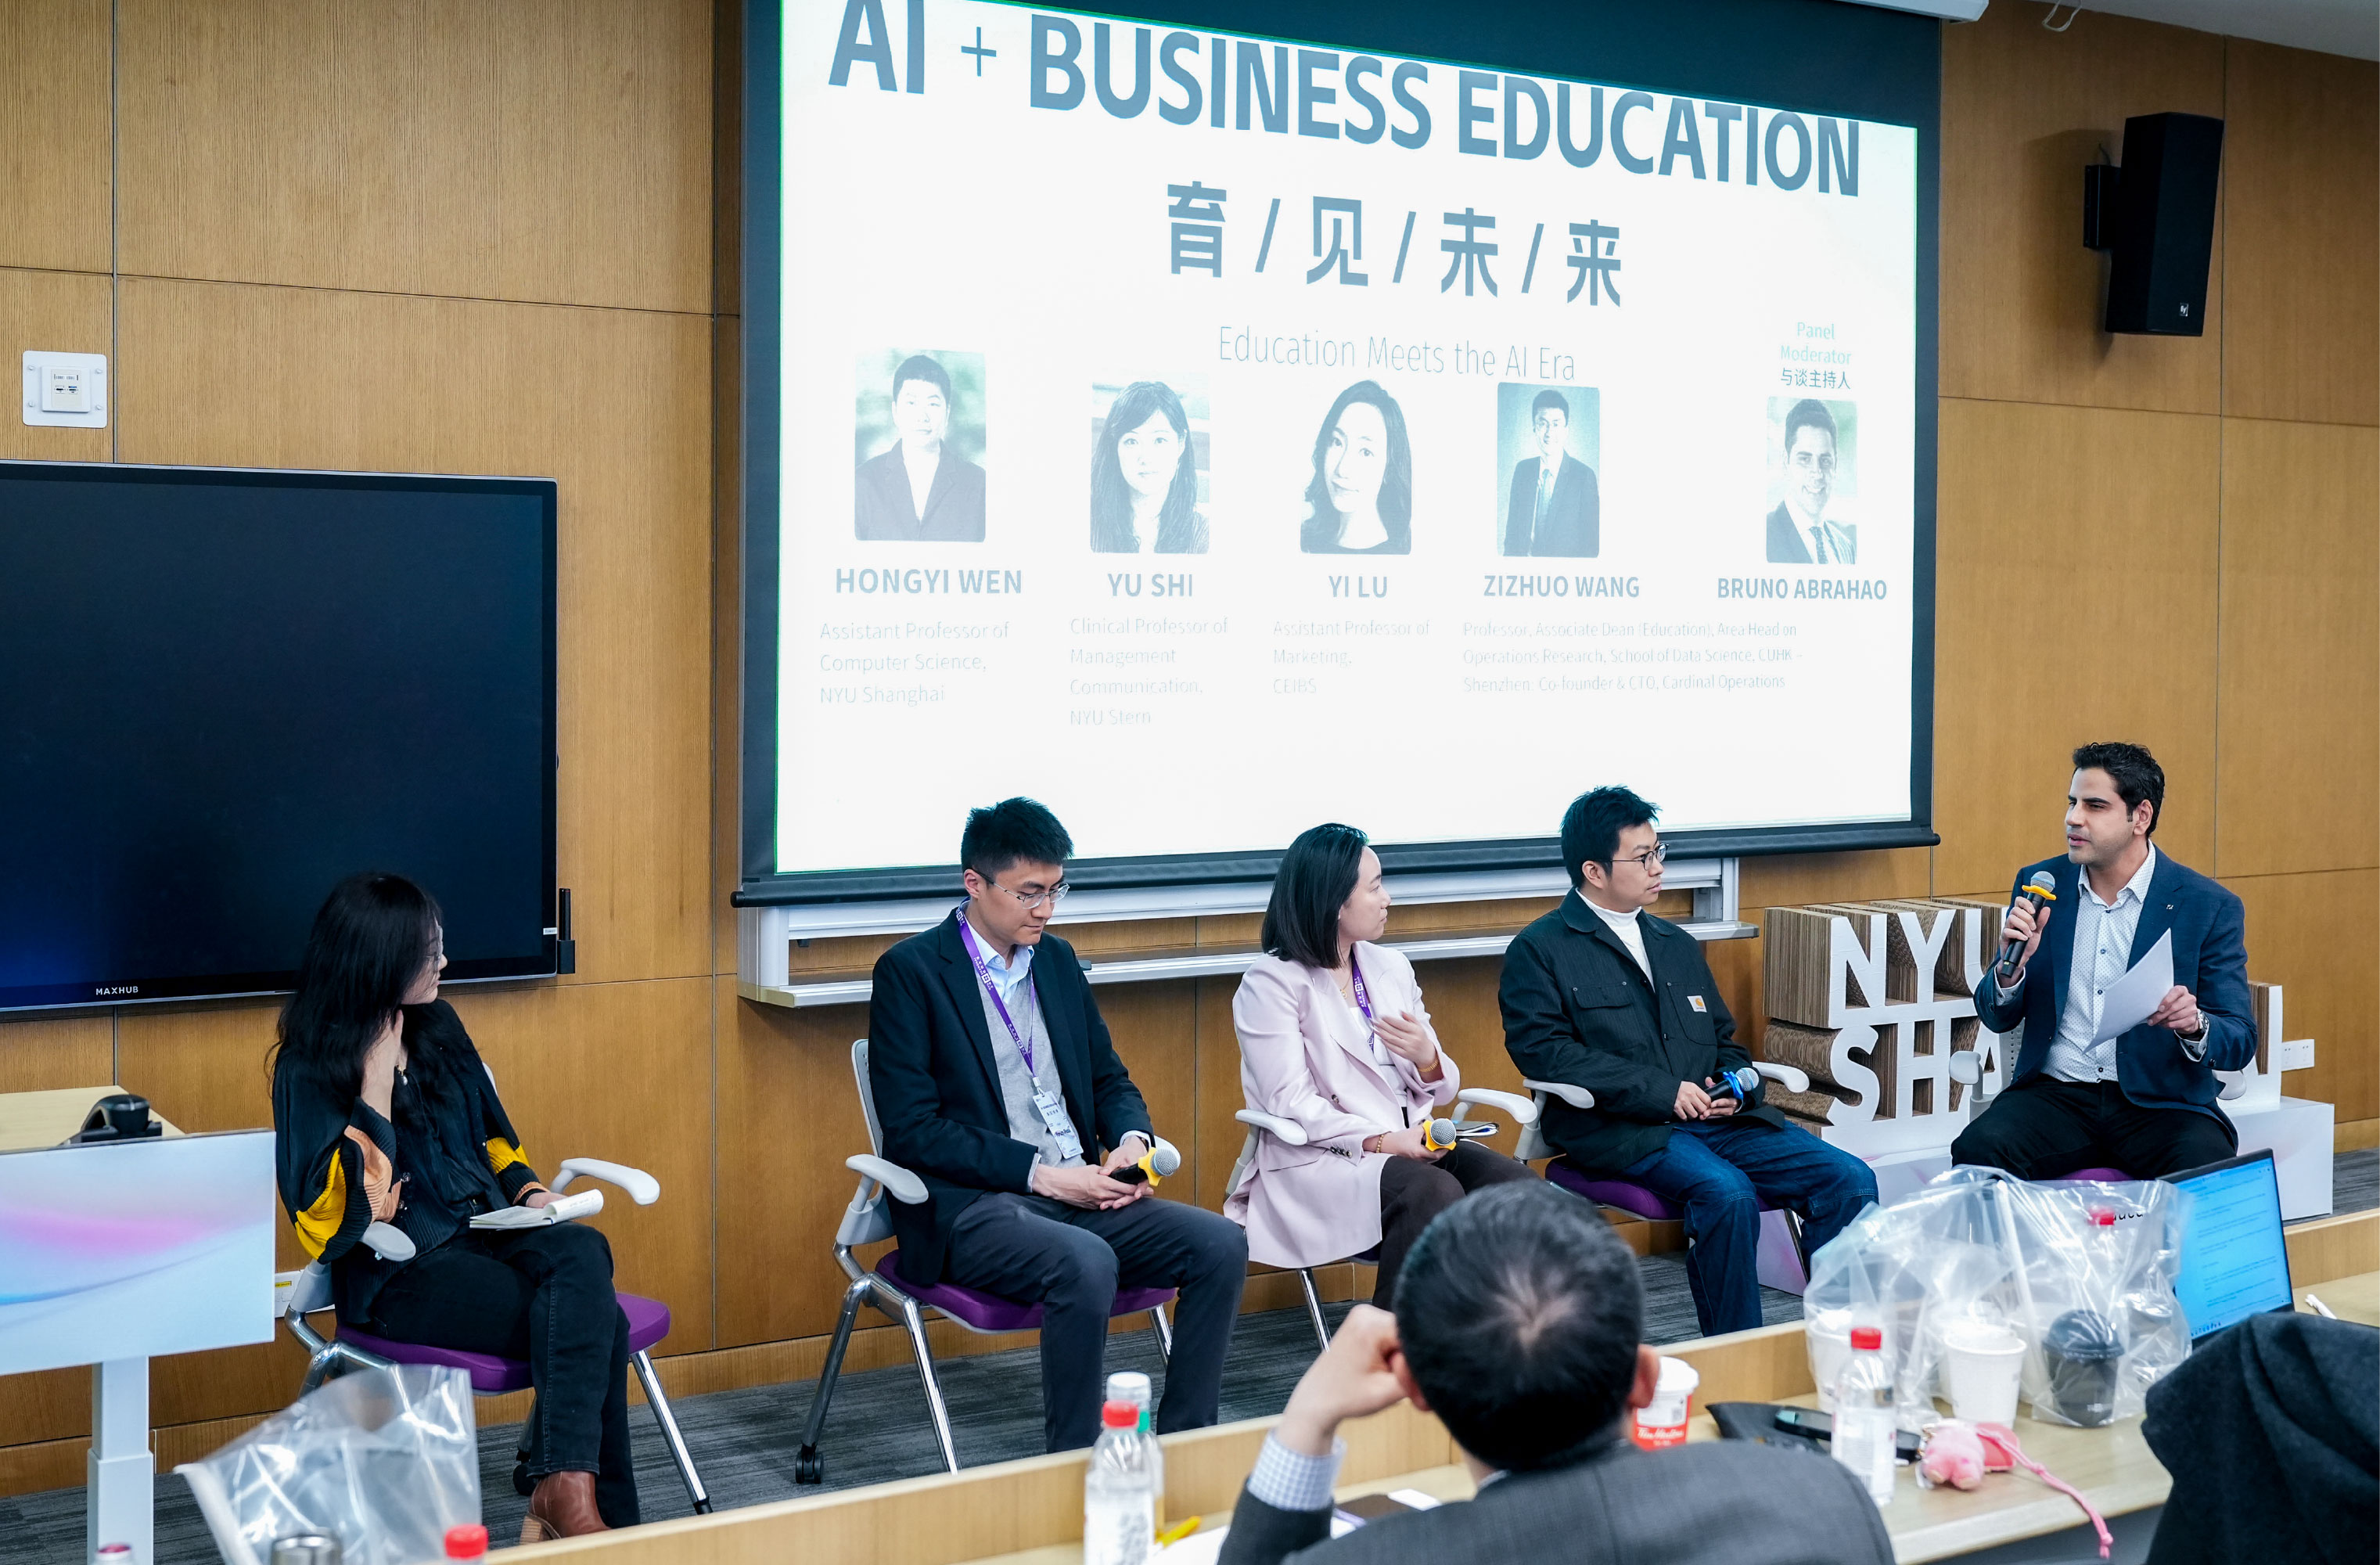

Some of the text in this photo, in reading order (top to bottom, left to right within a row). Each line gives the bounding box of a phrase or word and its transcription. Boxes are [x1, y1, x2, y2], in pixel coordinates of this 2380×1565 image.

[828, 0, 926, 95] AI
[1030, 13, 1432, 150] BUSINESS
[1458, 69, 1860, 198] EDUCATION
[1796, 321, 1835, 341] Panel
[1219, 325, 1576, 381] Education Meets the AI Era
[1780, 343, 1853, 365] Moderator
[1780, 366, 1852, 390] 与谈主持人
[836, 568, 1023, 595] HONGYI WEN
[1107, 573, 1193, 598] YU SHI
[1328, 575, 1389, 599] YI LU
[1483, 574, 1640, 599] ZIZHUO WANG
[1717, 577, 1888, 601] BRUNO ABRAHAO
[819, 621, 1010, 640] Assistant Professor of
[1070, 615, 1228, 635] Clinical Professor of
[1273, 619, 1431, 637] Assistant Professor of
[1536, 621, 1598, 638] Associate
[1602, 622, 1634, 637] Dean
[1717, 621, 1745, 637] Area
[1748, 621, 1780, 636] Head
[1782, 624, 1797, 636] on
[819, 652, 987, 675] Computer Science,
[1070, 647, 1177, 670] Management
[1463, 648, 1539, 667] Operations
[1610, 648, 1654, 664] School
[1657, 647, 1670, 664] of
[1673, 647, 1702, 664] Data
[1759, 647, 1793, 662] CUHK
[1272, 677, 1318, 696] CEIBS
[1616, 675, 1625, 691] &
[1663, 674, 1715, 690] Cardinal
[1717, 673, 1785, 693] Operations
[819, 684, 946, 708] NYU Shanghai
[1070, 708, 1152, 727] NYU Stern
[1828, 906, 2009, 1011] NYU
[95, 986, 138, 996] MAXHUB
